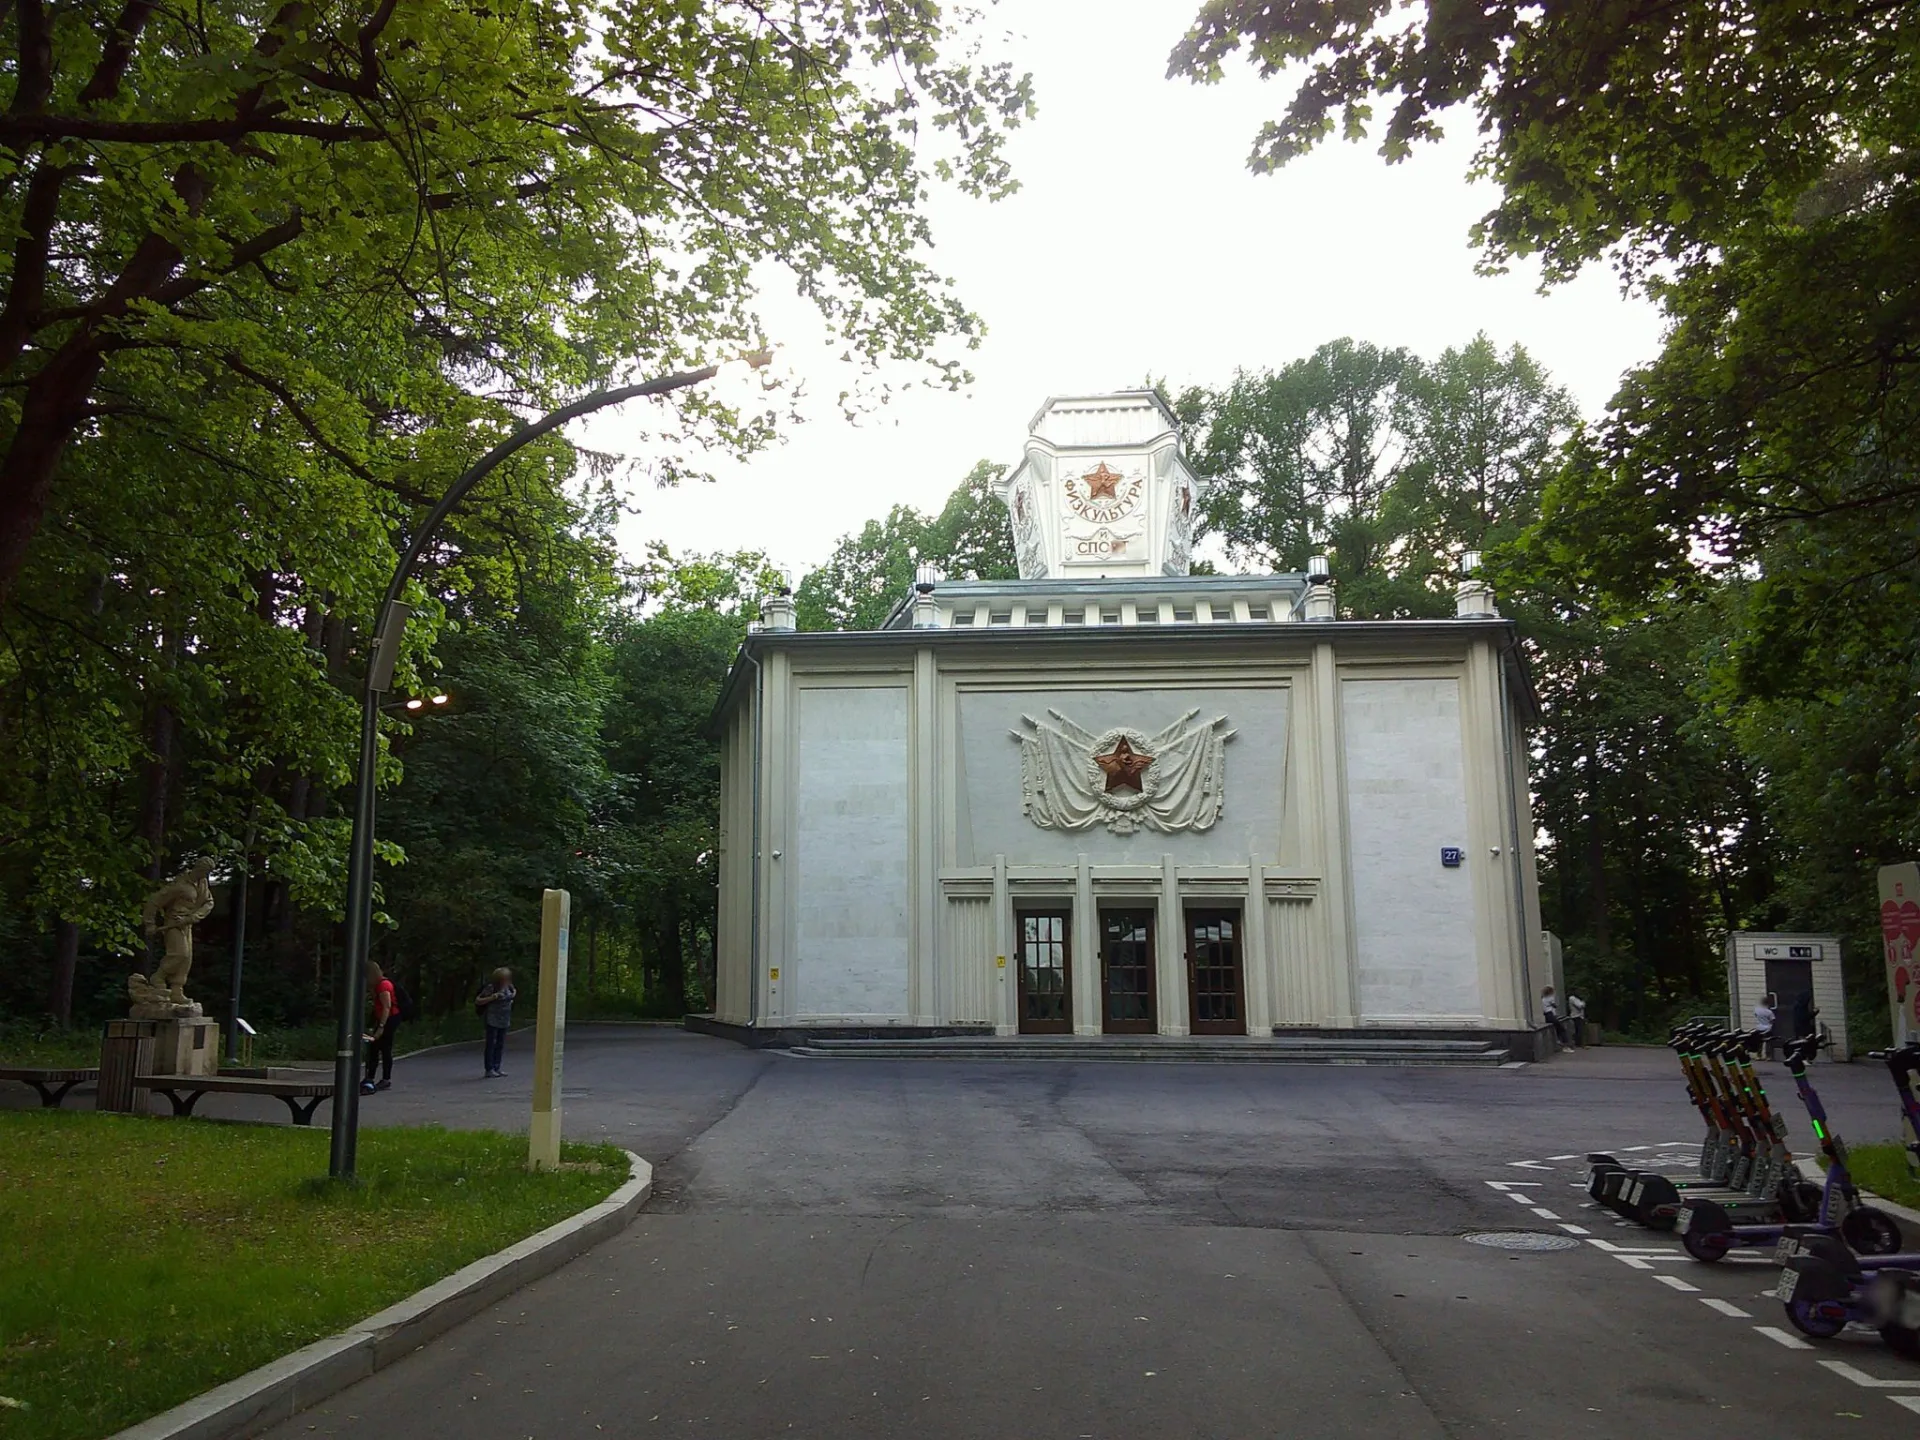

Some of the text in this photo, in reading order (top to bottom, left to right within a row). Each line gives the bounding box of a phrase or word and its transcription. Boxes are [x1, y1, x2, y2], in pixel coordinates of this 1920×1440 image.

[1064, 478, 1143, 521] ФИЗКУЛЬТУРА
[1077, 540, 1129, 553] СПО
[1445, 850, 1457, 860] 27
[1764, 947, 1778, 955] WC
